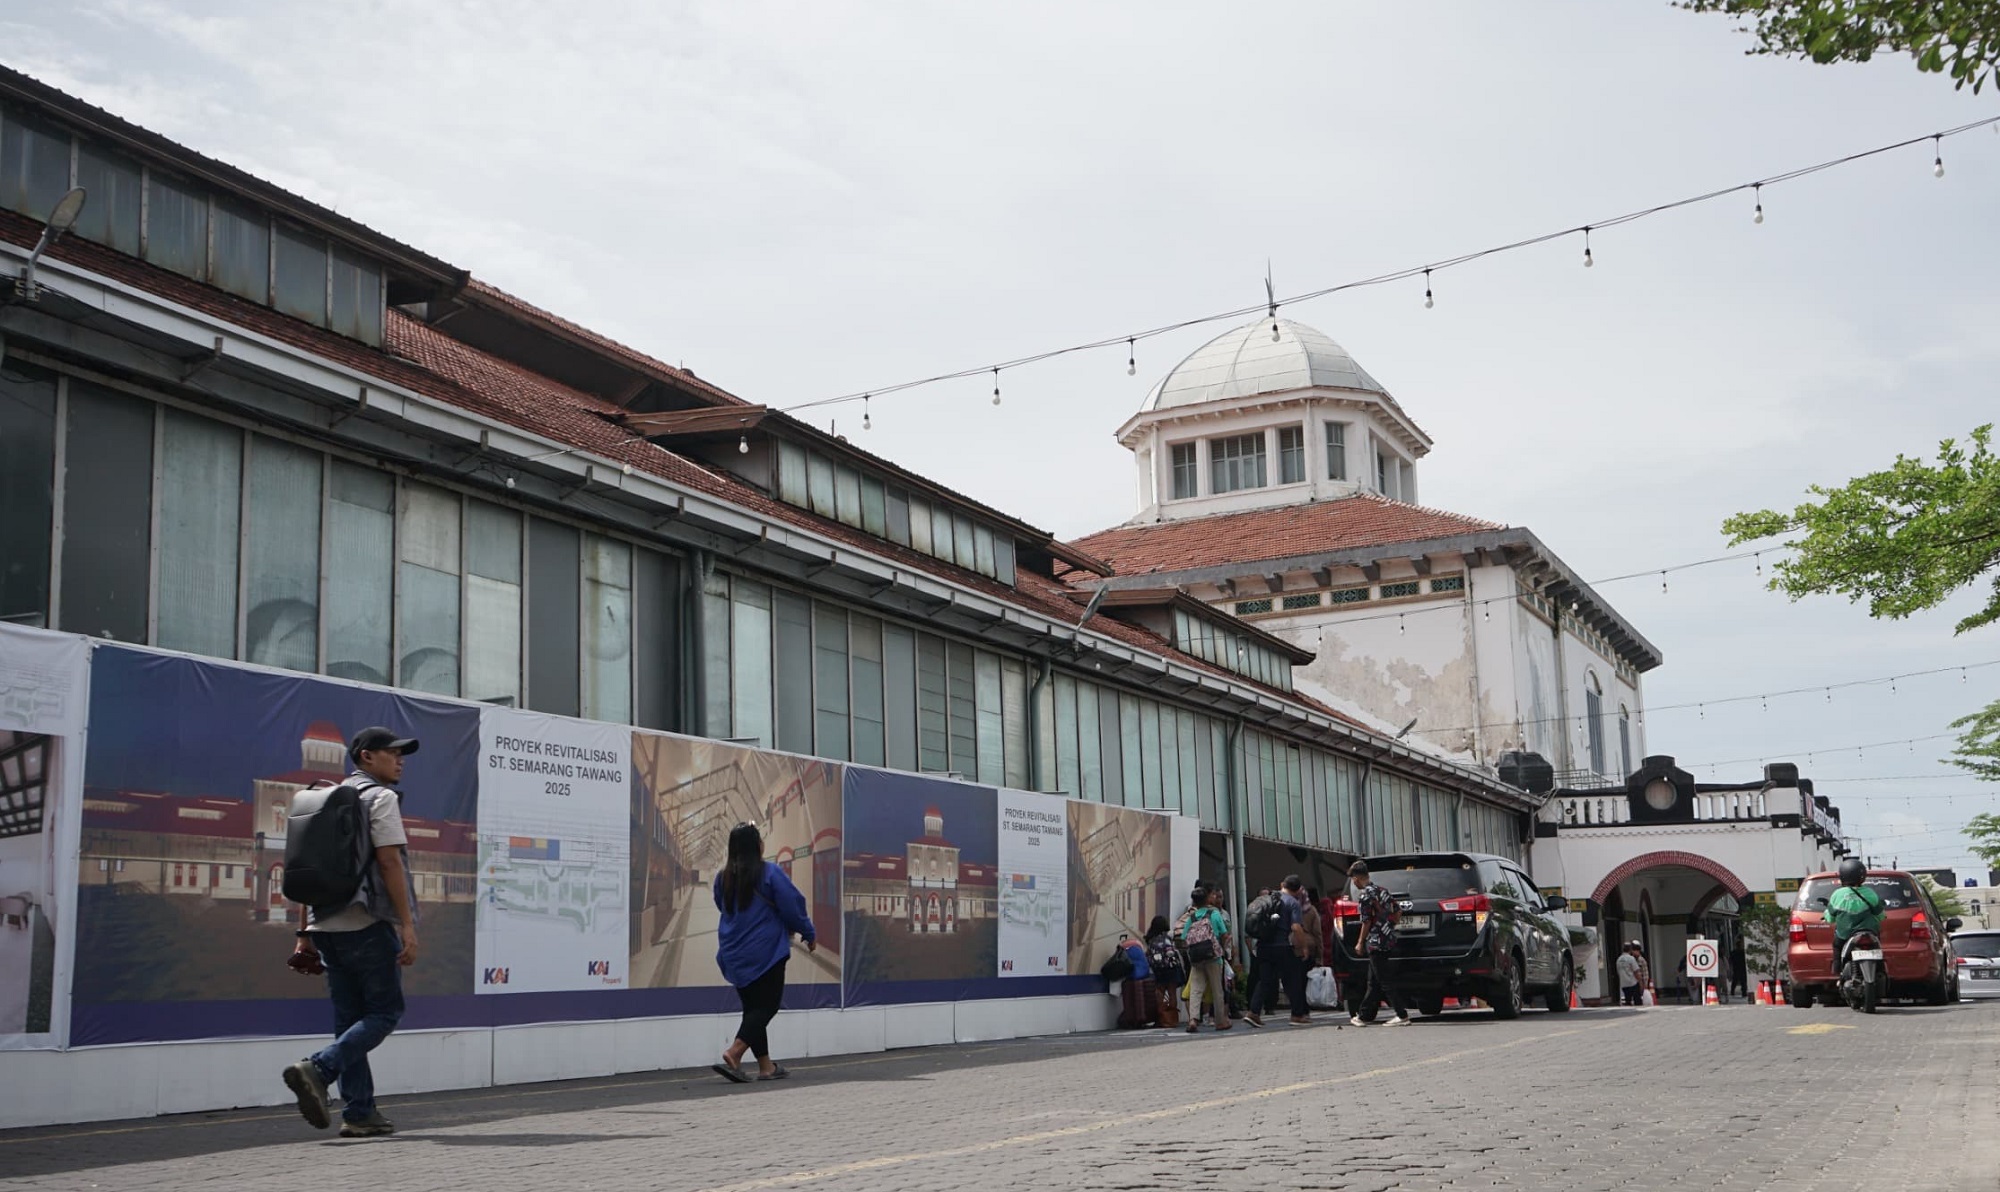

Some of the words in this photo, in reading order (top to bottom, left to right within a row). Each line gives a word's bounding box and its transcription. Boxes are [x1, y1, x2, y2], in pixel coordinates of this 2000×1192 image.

[495, 735, 542, 755] PROYEK
[545, 743, 617, 764] REVITALISASI
[489, 754, 506, 769] ST.
[509, 757, 573, 778] SEMARANG
[576, 766, 622, 783] TAWANG
[545, 781, 571, 796] 2025
[1005, 808, 1026, 819] PROYEK
[1027, 810, 1061, 823] REVITALISASI
[1011, 821, 1041, 834] SEMARANG
[1042, 825, 1063, 836] TAWANG
[1027, 836, 1040, 846] 2025
[1692, 953, 1709, 966] 10
